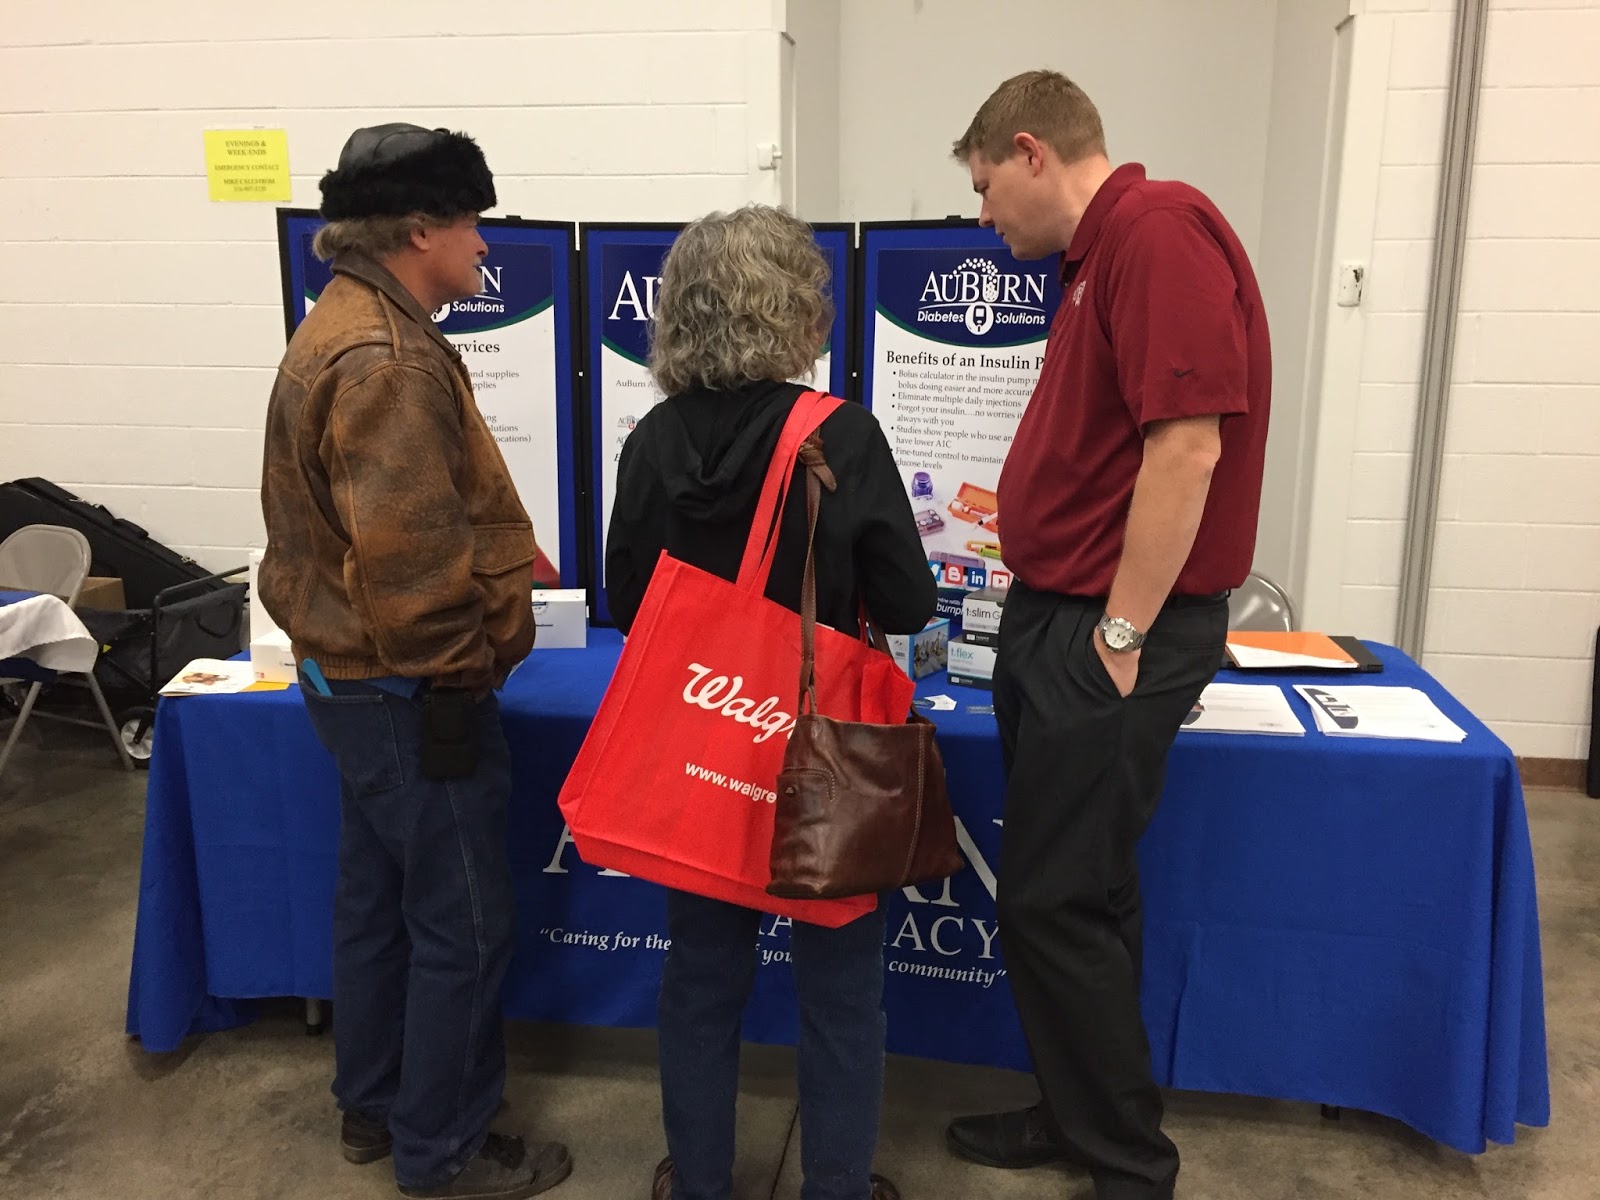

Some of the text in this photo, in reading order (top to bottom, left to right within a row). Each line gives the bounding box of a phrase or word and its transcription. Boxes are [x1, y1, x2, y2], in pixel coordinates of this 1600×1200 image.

[452, 301, 505, 313] Solutions
[917, 310, 1046, 326] Diabetes Solutions
[887, 350, 939, 366] Benefits
[942, 352, 957, 366] of
[959, 357, 976, 367] an
[980, 354, 1030, 370] Insulin
[486, 370, 520, 380] supplies
[898, 369, 919, 379] Bolus
[919, 371, 955, 381] calculator
[956, 373, 964, 381] in
[965, 373, 978, 381] the
[979, 374, 1005, 383] insulin
[1007, 377, 1031, 387] pump
[472, 381, 497, 391] pplies
[898, 380, 1033, 397] bolus dosing easier and more accurat
[898, 391, 1022, 408] Eliminate multiple daily injections
[484, 413, 497, 424] ing
[897, 403, 920, 414] Forgot
[921, 405, 939, 415] your
[986, 410, 1016, 419] worries
[896, 414, 955, 427] always with you
[896, 424, 922, 434] Studies
[923, 427, 942, 436] show
[943, 429, 969, 440] people
[970, 431, 987, 440] who
[896, 435, 913, 444] have
[914, 437, 934, 447] lower
[895, 446, 1004, 465] Fine-tuned control to maintain
[896, 458, 943, 470] glucose levels
[611, 931, 641, 951] for
[645, 933, 673, 951] the
